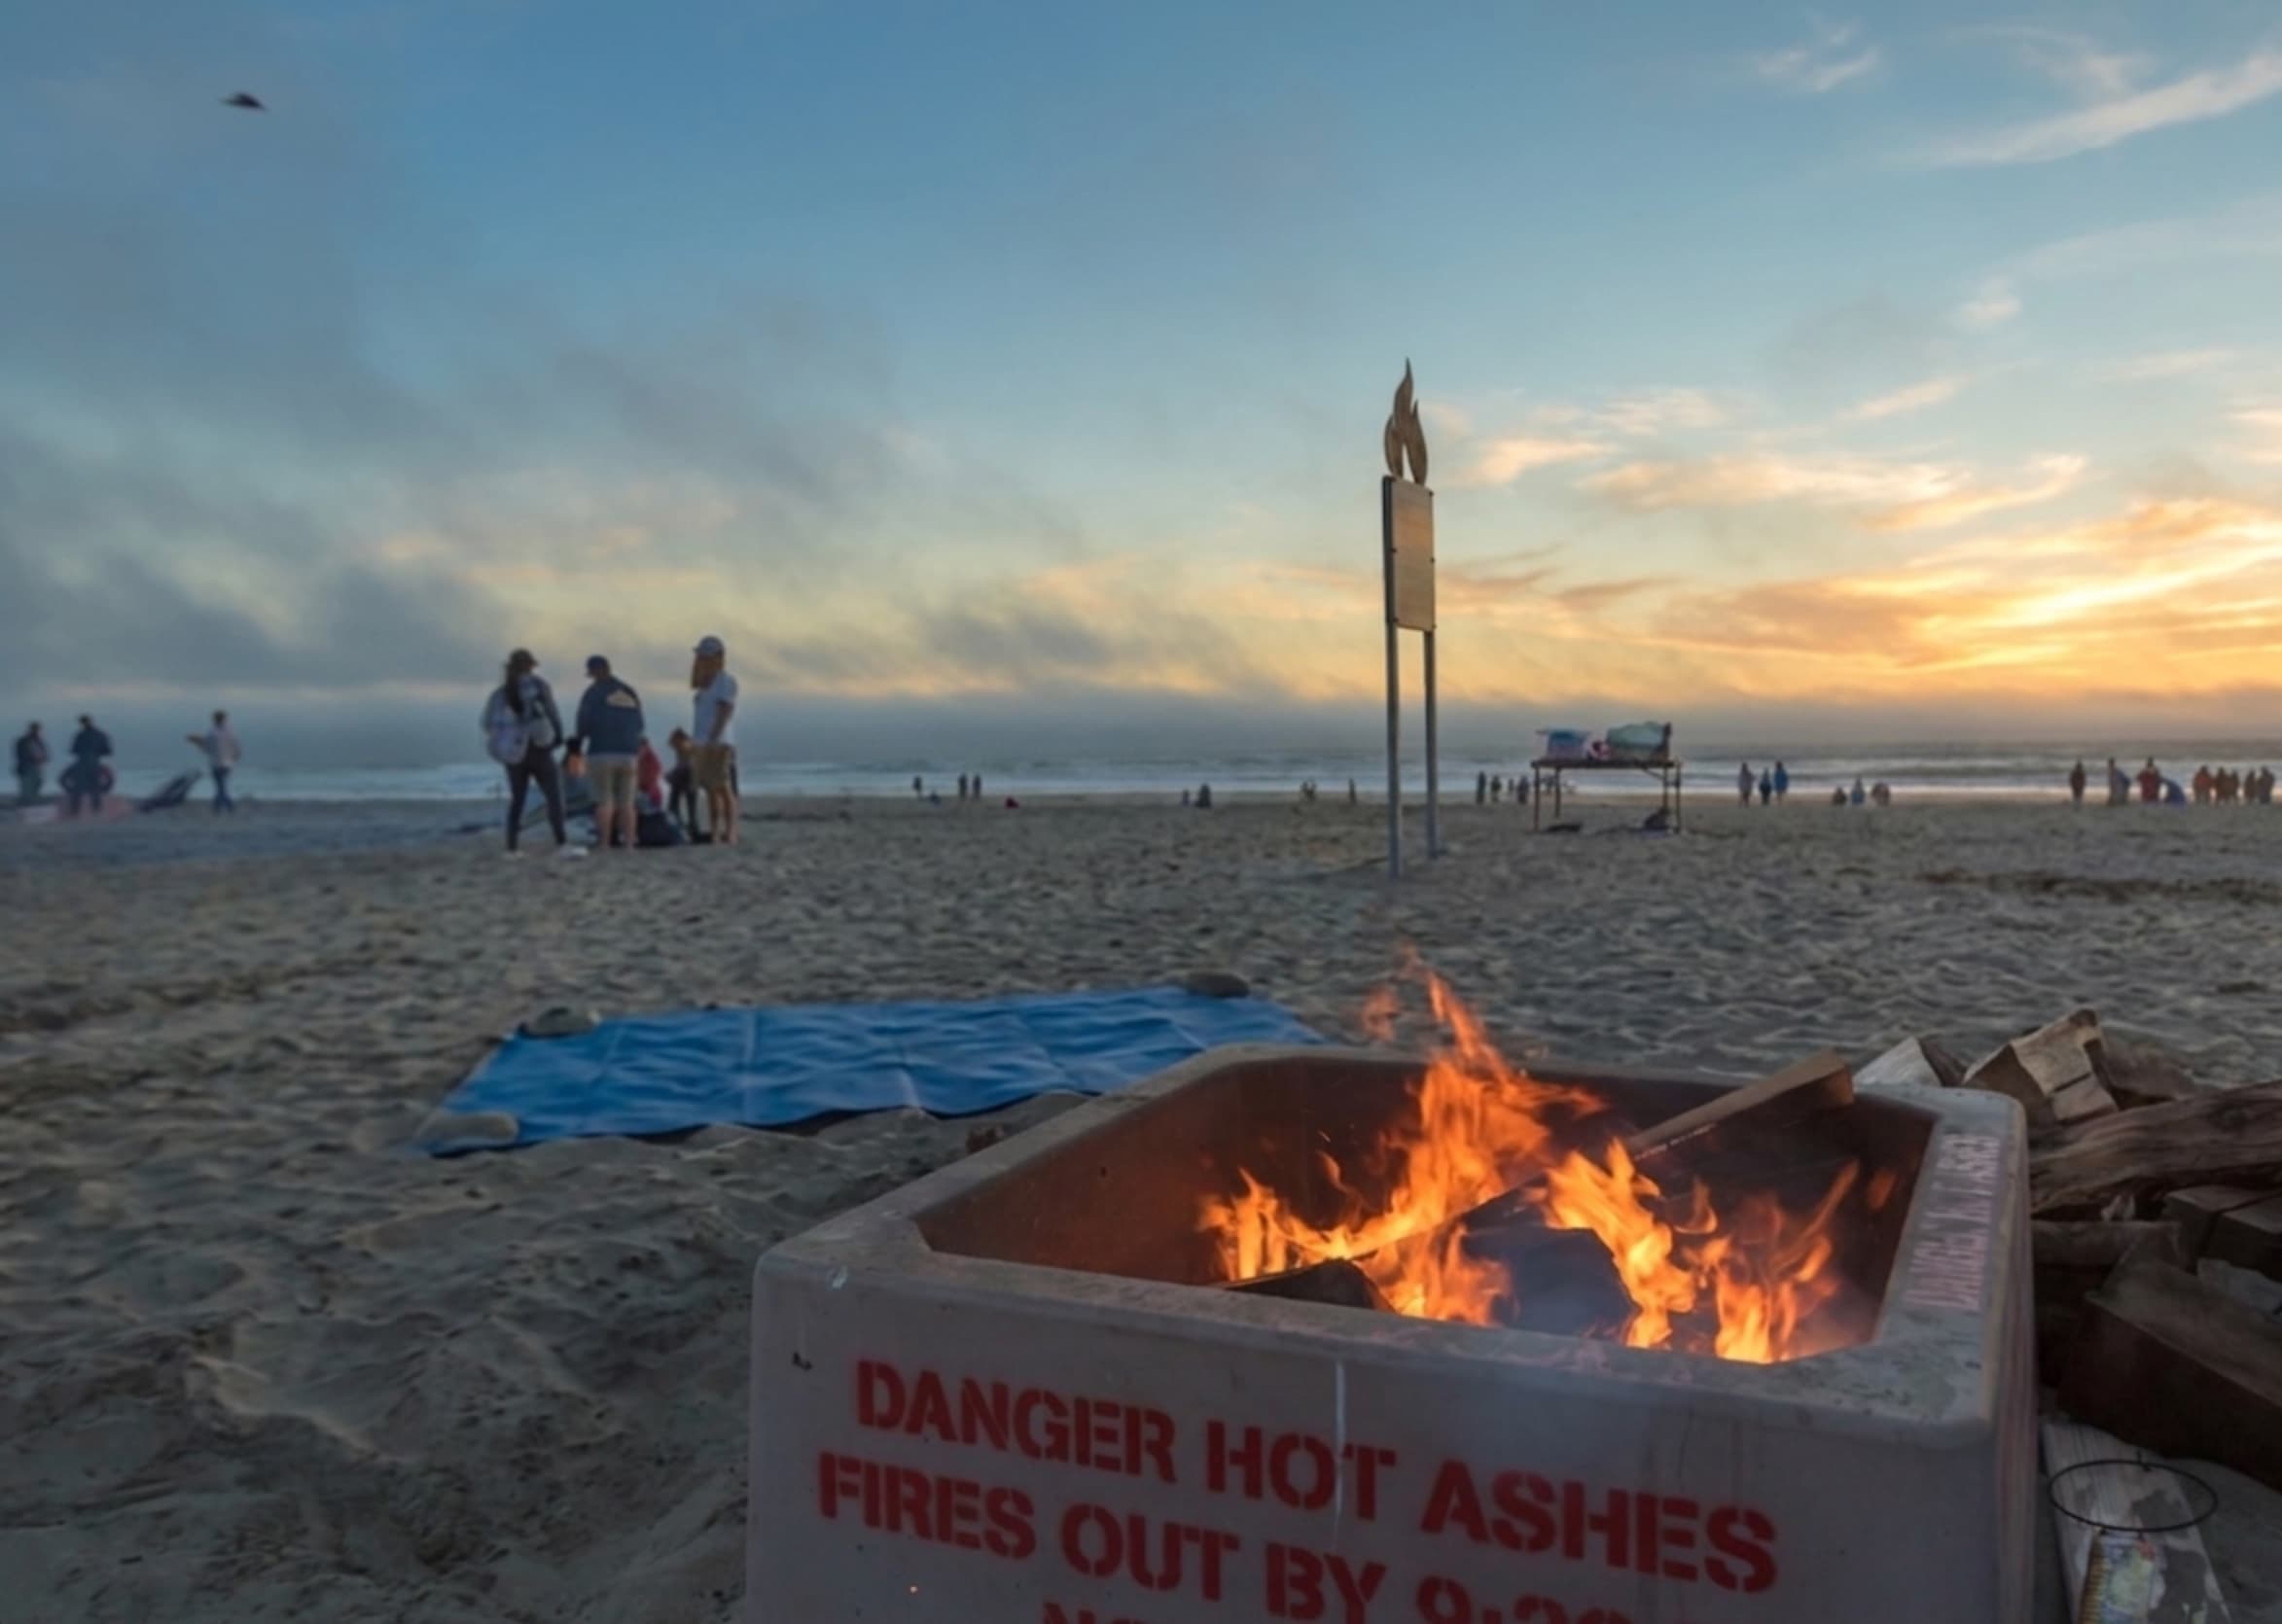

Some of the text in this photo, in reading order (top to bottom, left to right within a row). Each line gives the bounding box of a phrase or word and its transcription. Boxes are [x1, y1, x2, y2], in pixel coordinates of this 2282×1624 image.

[818, 1451, 1037, 1560] FIRES
[1059, 1502, 1240, 1602] OUT
[1266, 1542, 1386, 1624] BY
[855, 1359, 1778, 1594] DANGER HOT ASHES
